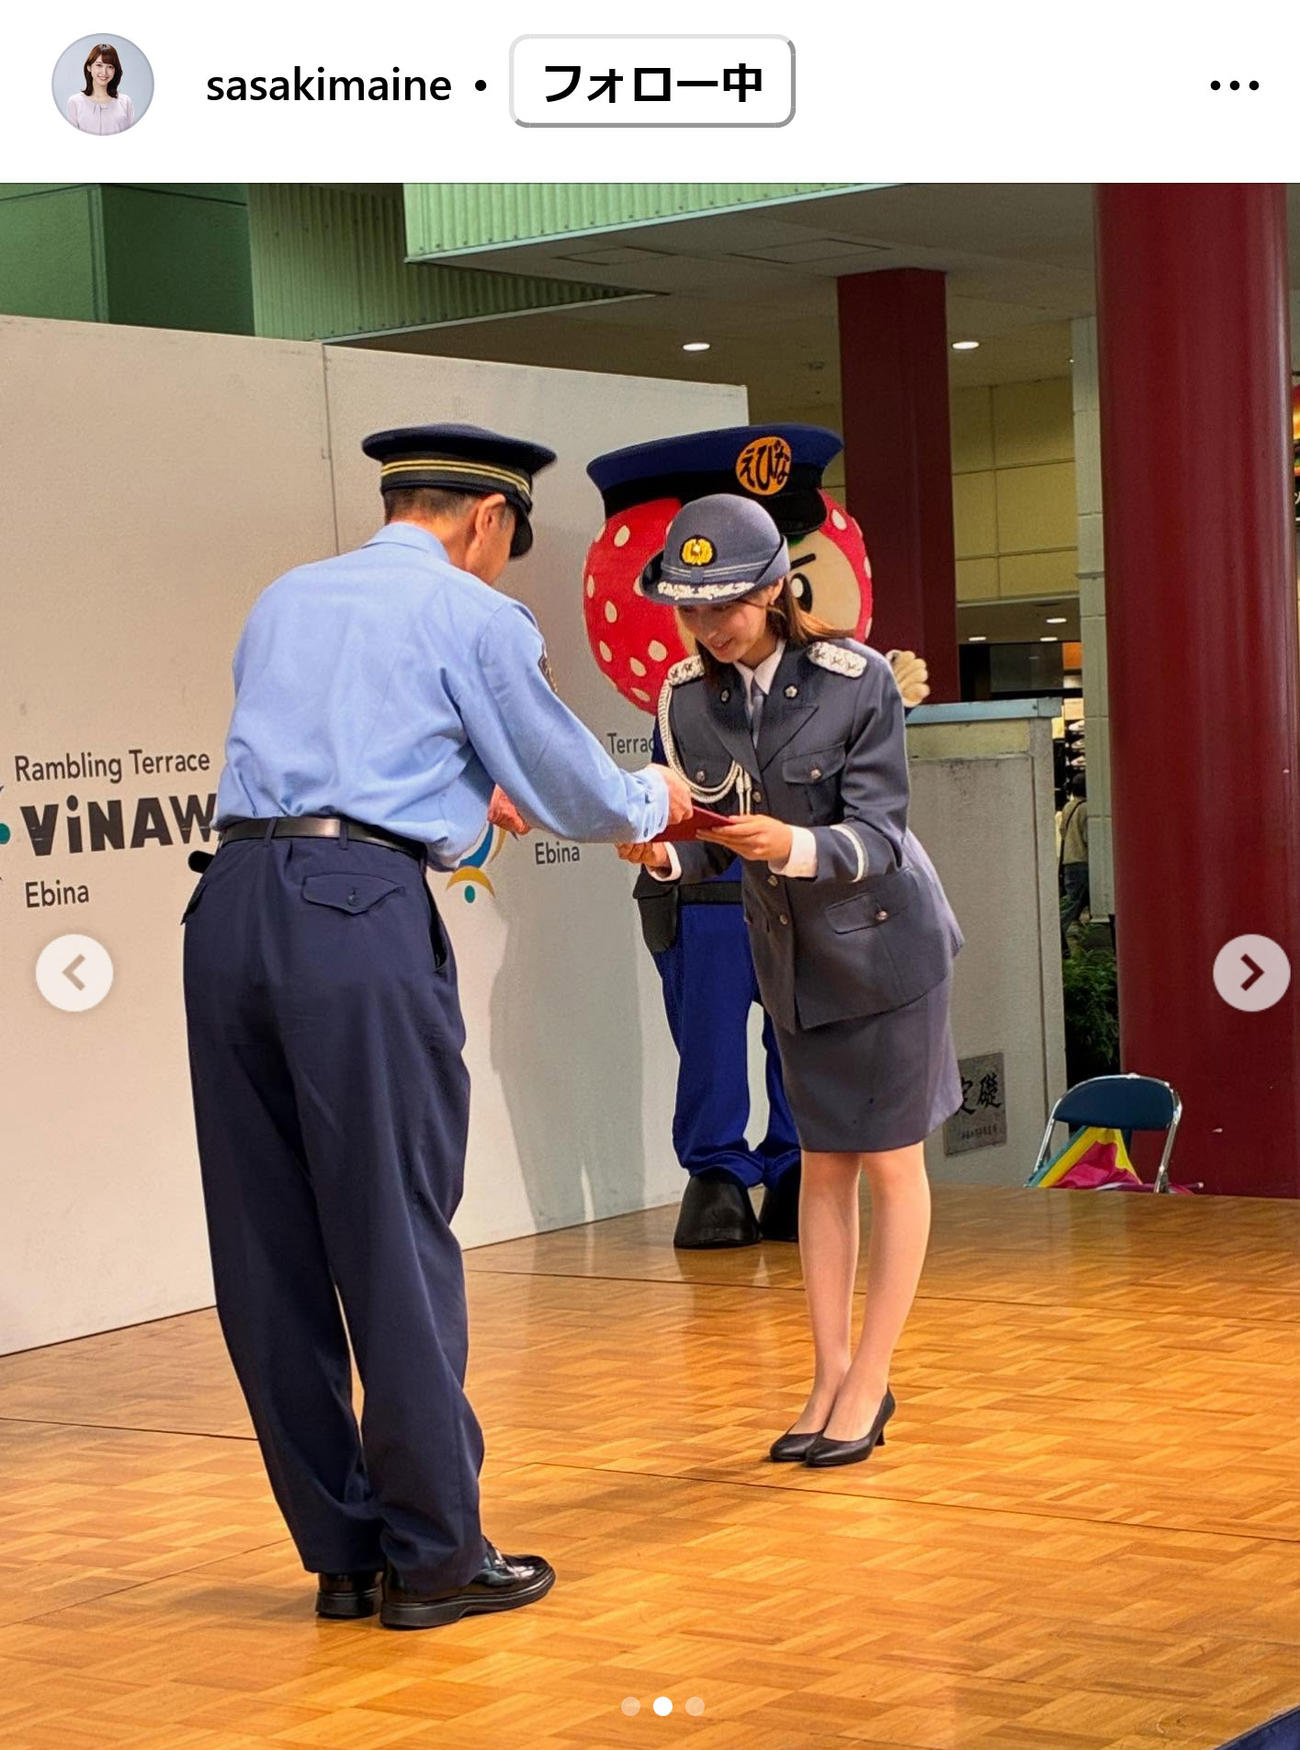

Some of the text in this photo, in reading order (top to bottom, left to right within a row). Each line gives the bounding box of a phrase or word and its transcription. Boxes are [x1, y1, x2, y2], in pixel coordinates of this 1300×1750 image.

[739, 439, 789, 491] えびな
[14, 748, 210, 784] Rambling Terrace
[534, 841, 580, 865] Ebina
[25, 879, 90, 908] Ebina
